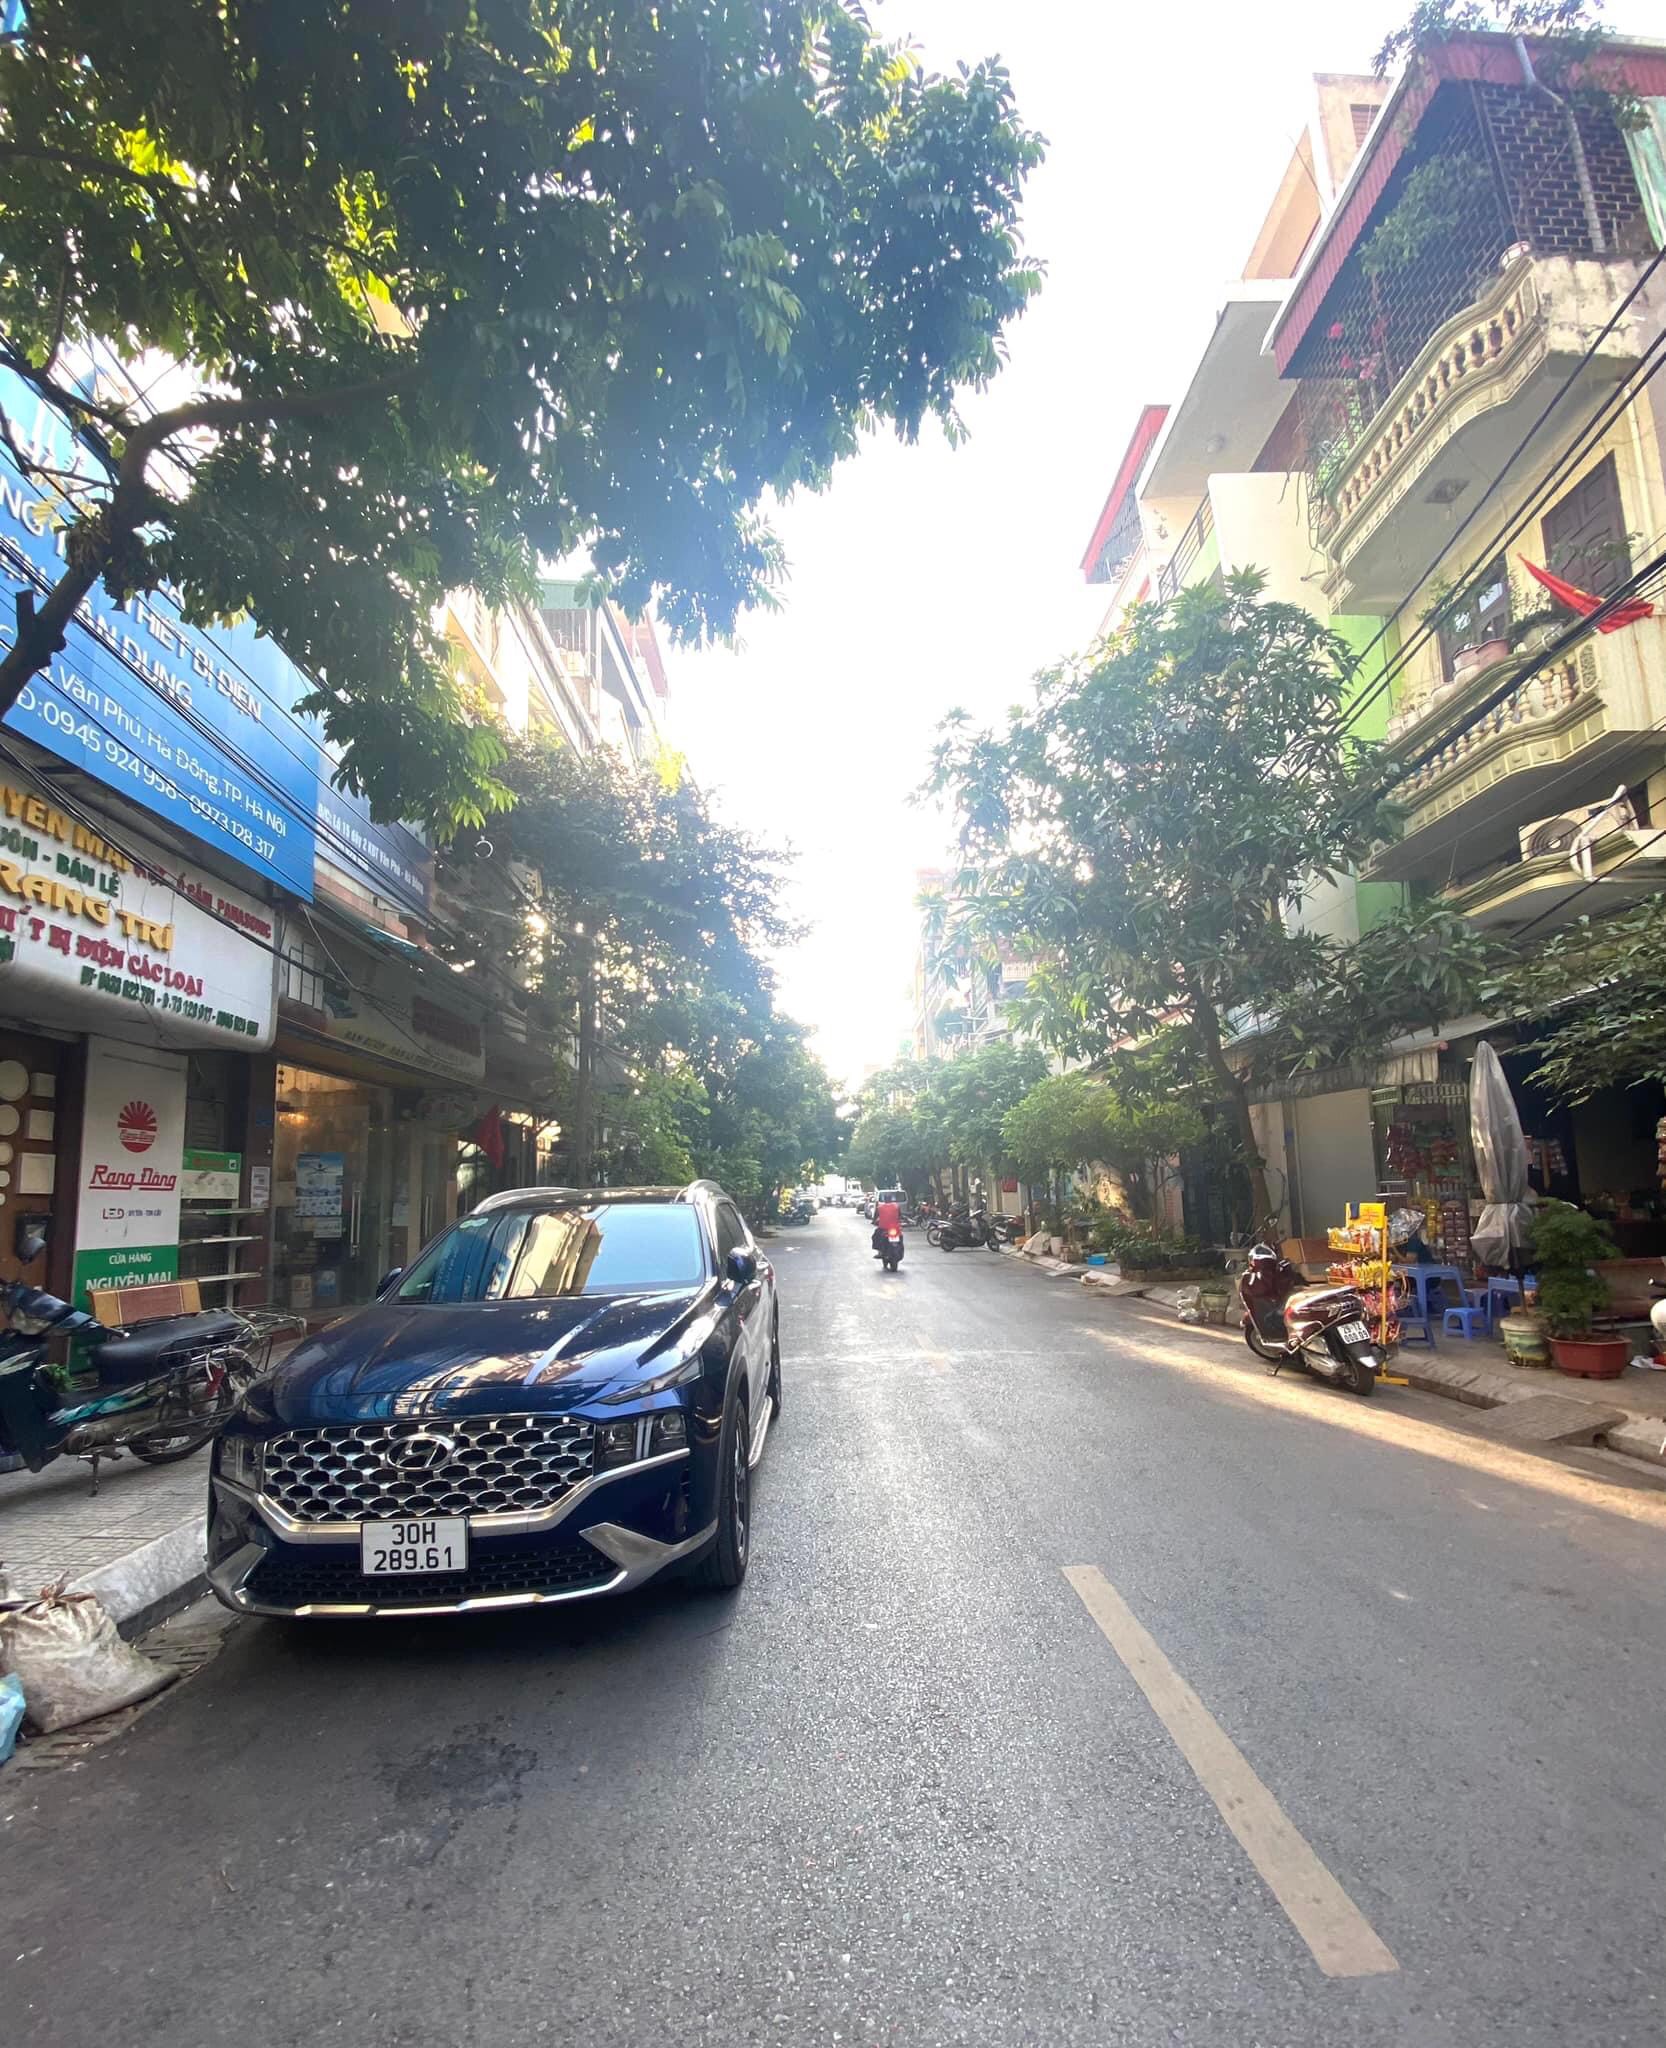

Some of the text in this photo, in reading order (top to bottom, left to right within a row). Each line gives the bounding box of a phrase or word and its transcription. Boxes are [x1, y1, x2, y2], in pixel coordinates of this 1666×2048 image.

[60, 665, 99, 711] Văn
[148, 728, 172, 760] Hà
[246, 796, 263, 821] Hà
[266, 808, 287, 839] Nội
[105, 740, 140, 778] 924
[143, 765, 177, 800] 958
[189, 794, 229, 832] 0973
[231, 820, 253, 847] 128
[255, 836, 276, 860] 317
[56, 852, 96, 888] BÁN
[0, 859, 174, 955] RANG TRÍ
[127, 953, 163, 983] CÁC
[163, 967, 204, 998] LOẠI
[103, 1208, 124, 1219] LED
[128, 1252, 152, 1264] HÀNG
[391, 1521, 436, 1546] 30H
[373, 1546, 452, 1572] 289.61
